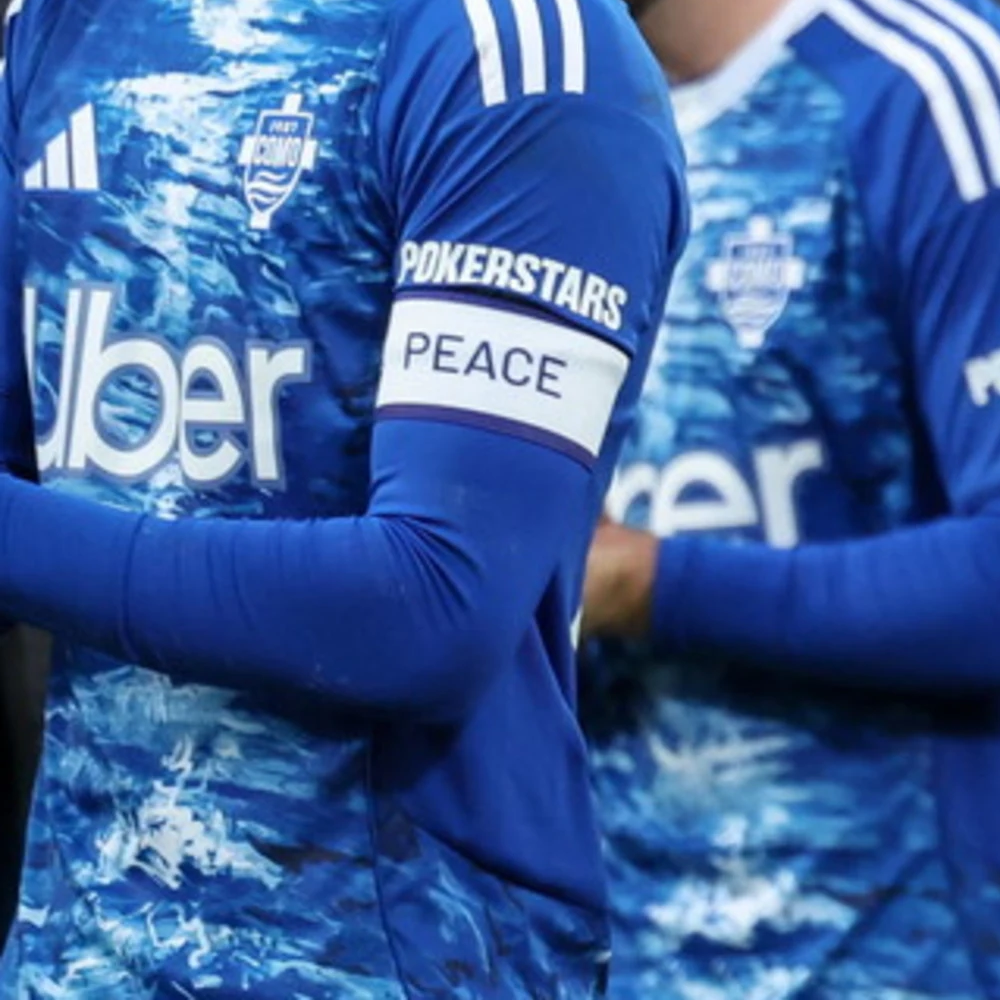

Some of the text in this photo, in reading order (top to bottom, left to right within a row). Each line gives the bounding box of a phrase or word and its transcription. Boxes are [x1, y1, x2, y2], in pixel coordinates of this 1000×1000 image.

[397, 241, 628, 331] POKERSTARS
[23, 284, 307, 482] Uber
[403, 331, 568, 399] PEACE
